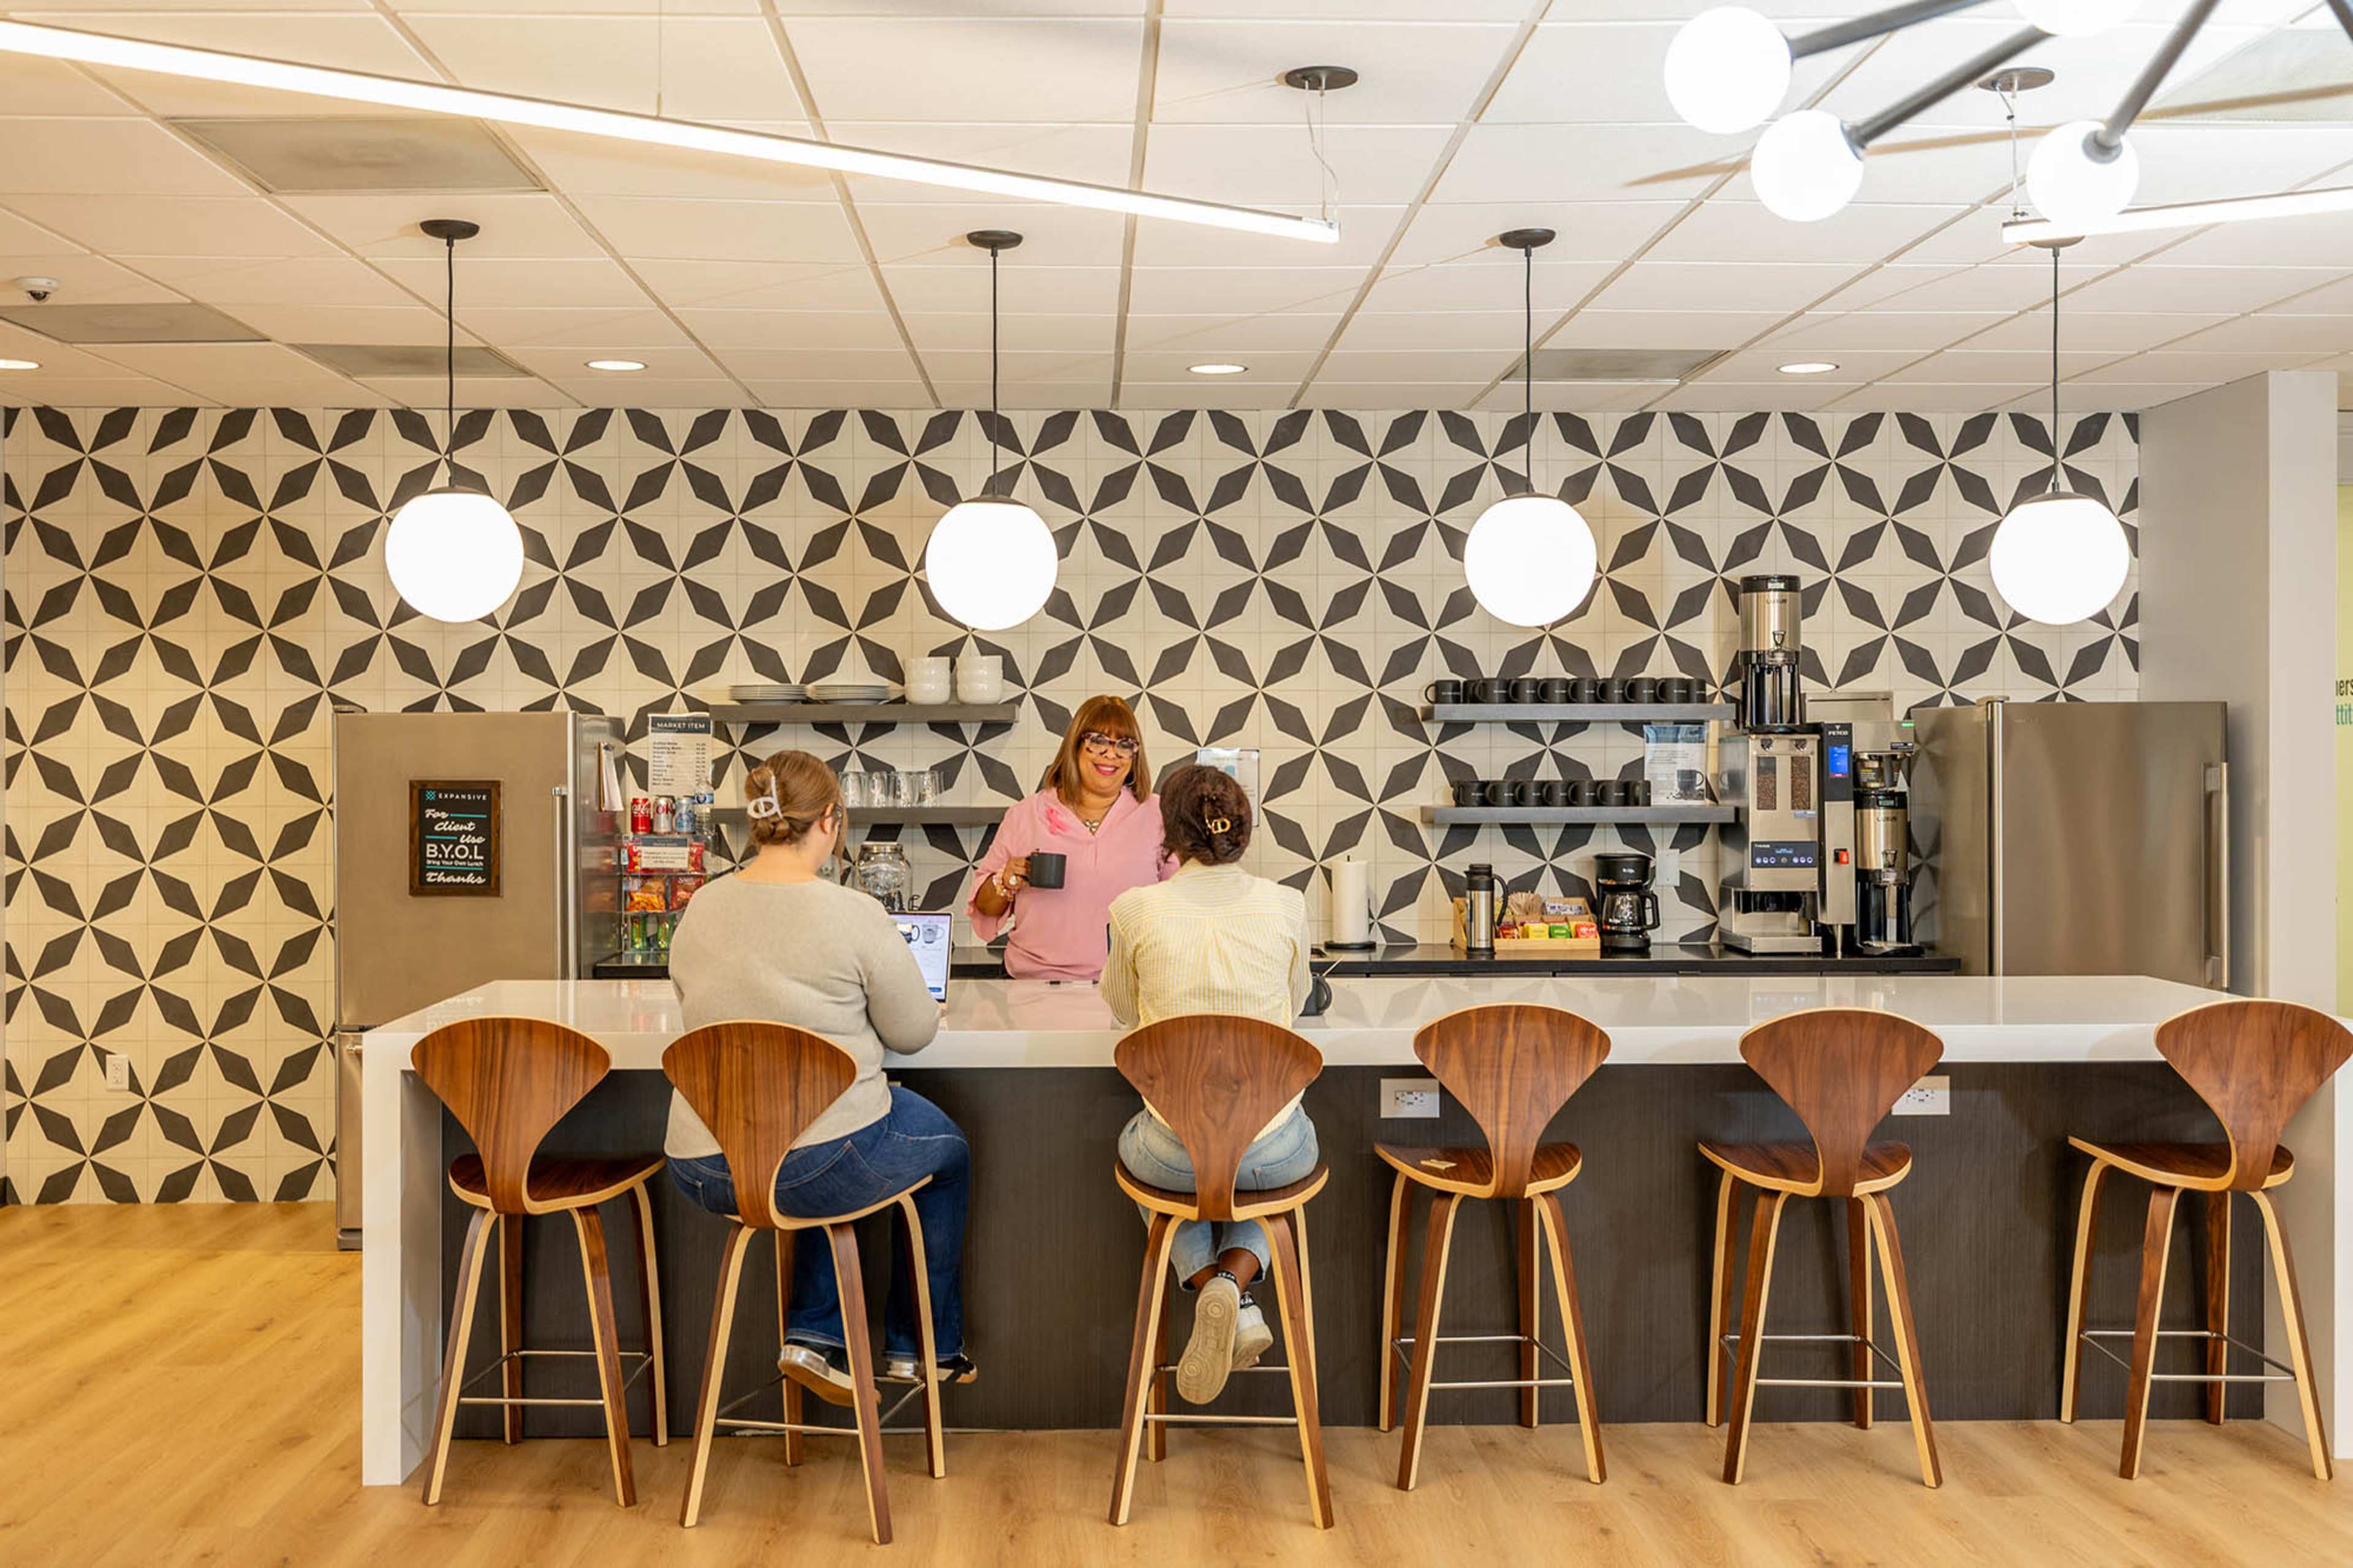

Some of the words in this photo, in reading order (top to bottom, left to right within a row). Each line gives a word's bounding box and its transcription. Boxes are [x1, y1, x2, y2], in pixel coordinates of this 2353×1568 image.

[425, 808, 449, 819] For
[460, 834, 486, 844] Use
[426, 843, 484, 860] B.Y.O.L
[425, 871, 486, 884] Thanks
